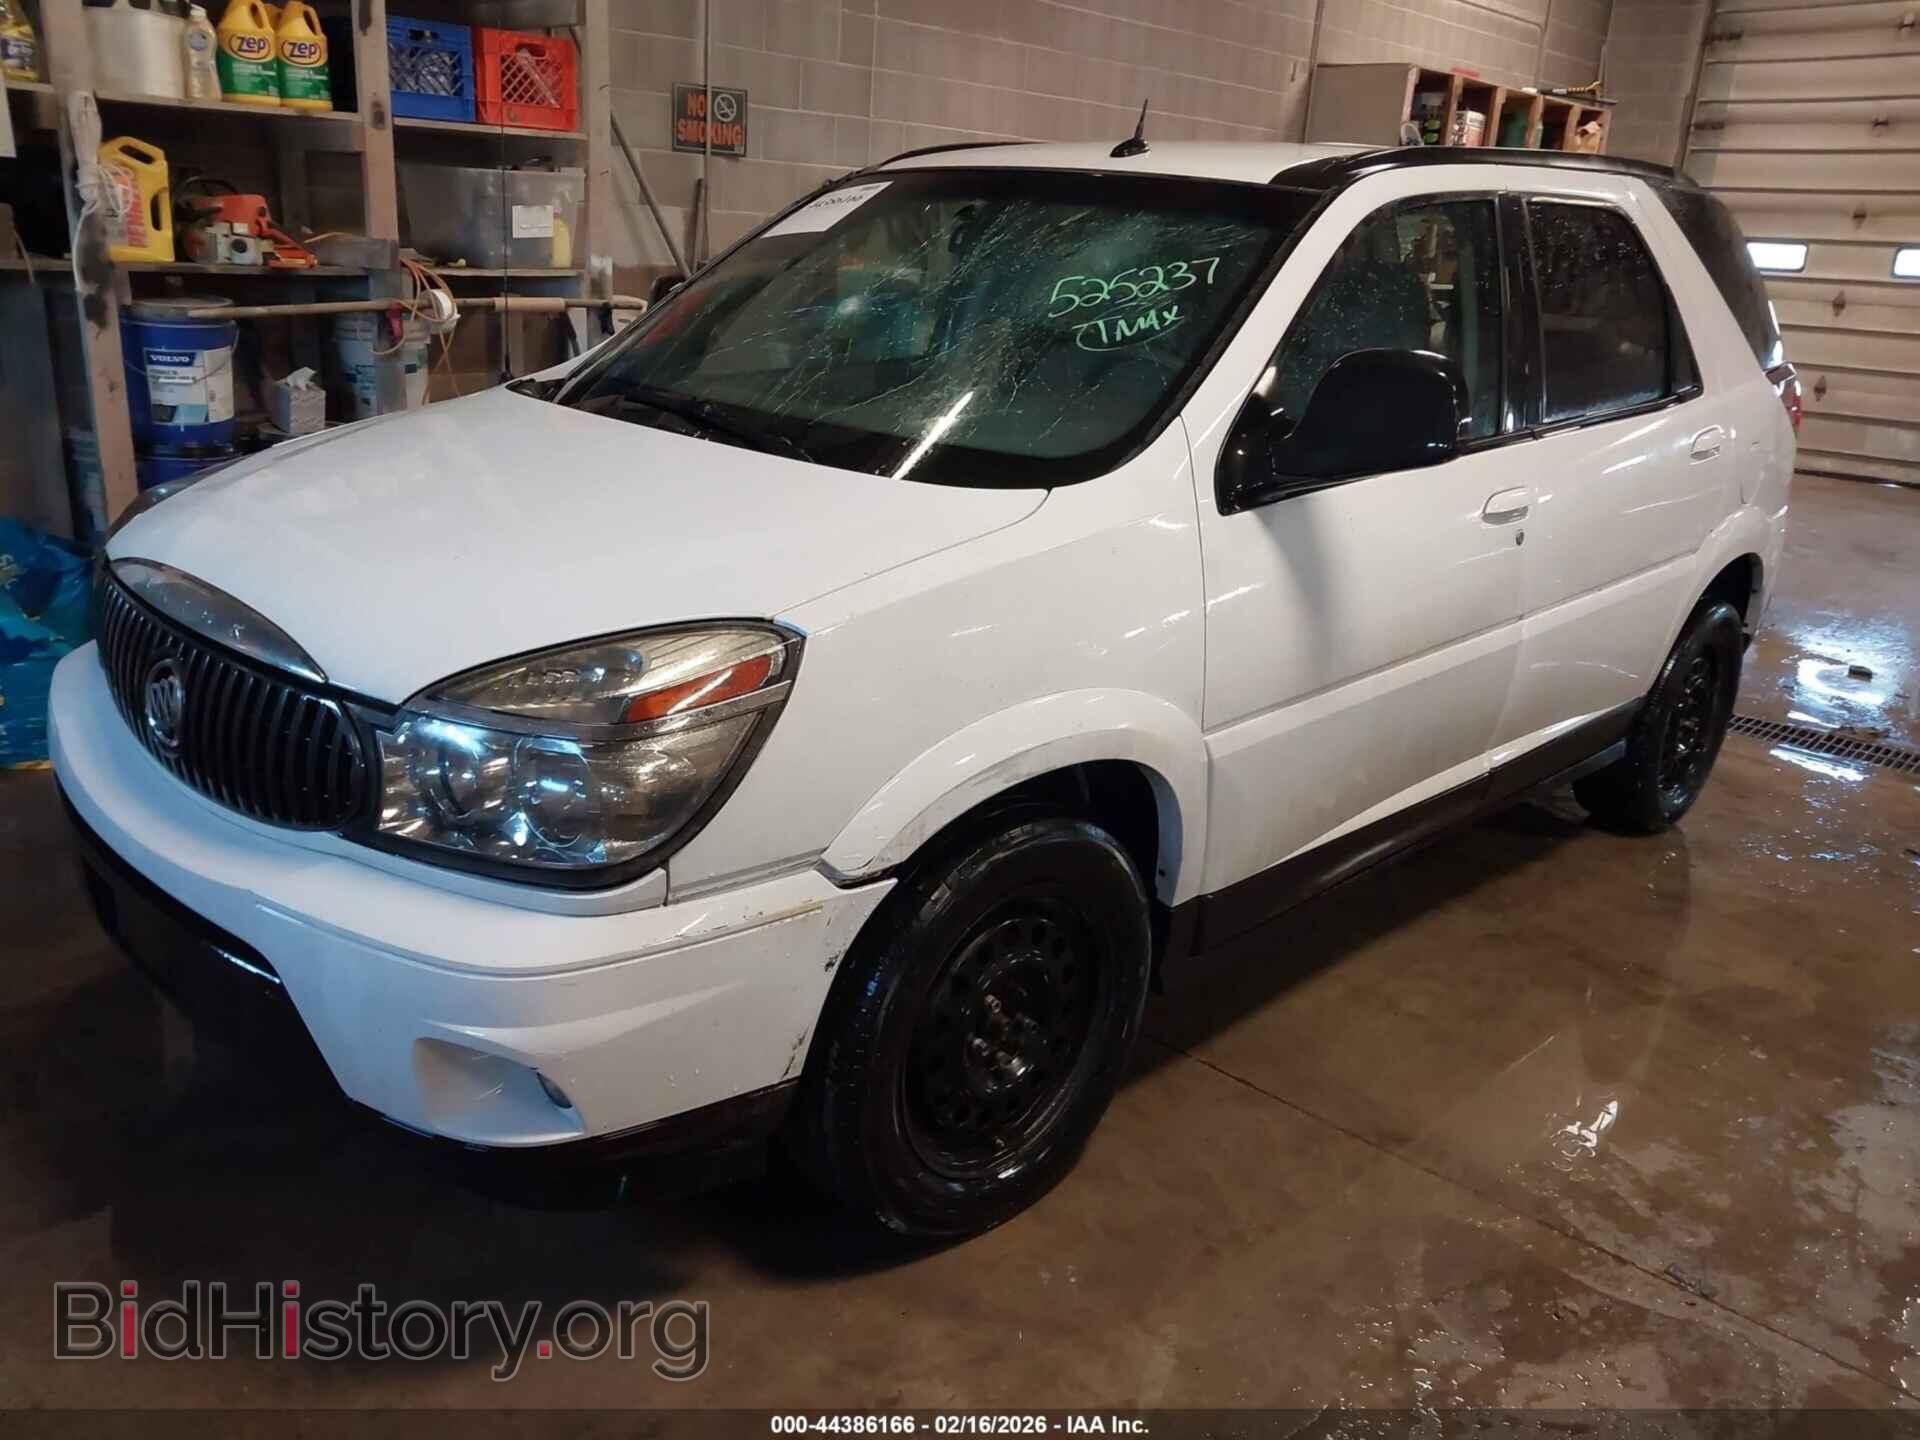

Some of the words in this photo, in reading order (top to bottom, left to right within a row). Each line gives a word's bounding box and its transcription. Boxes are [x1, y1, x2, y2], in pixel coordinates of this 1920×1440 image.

[687, 92, 706, 117] NO
[1048, 256, 1220, 318] 525237
[149, 354, 190, 363] VOLVO
